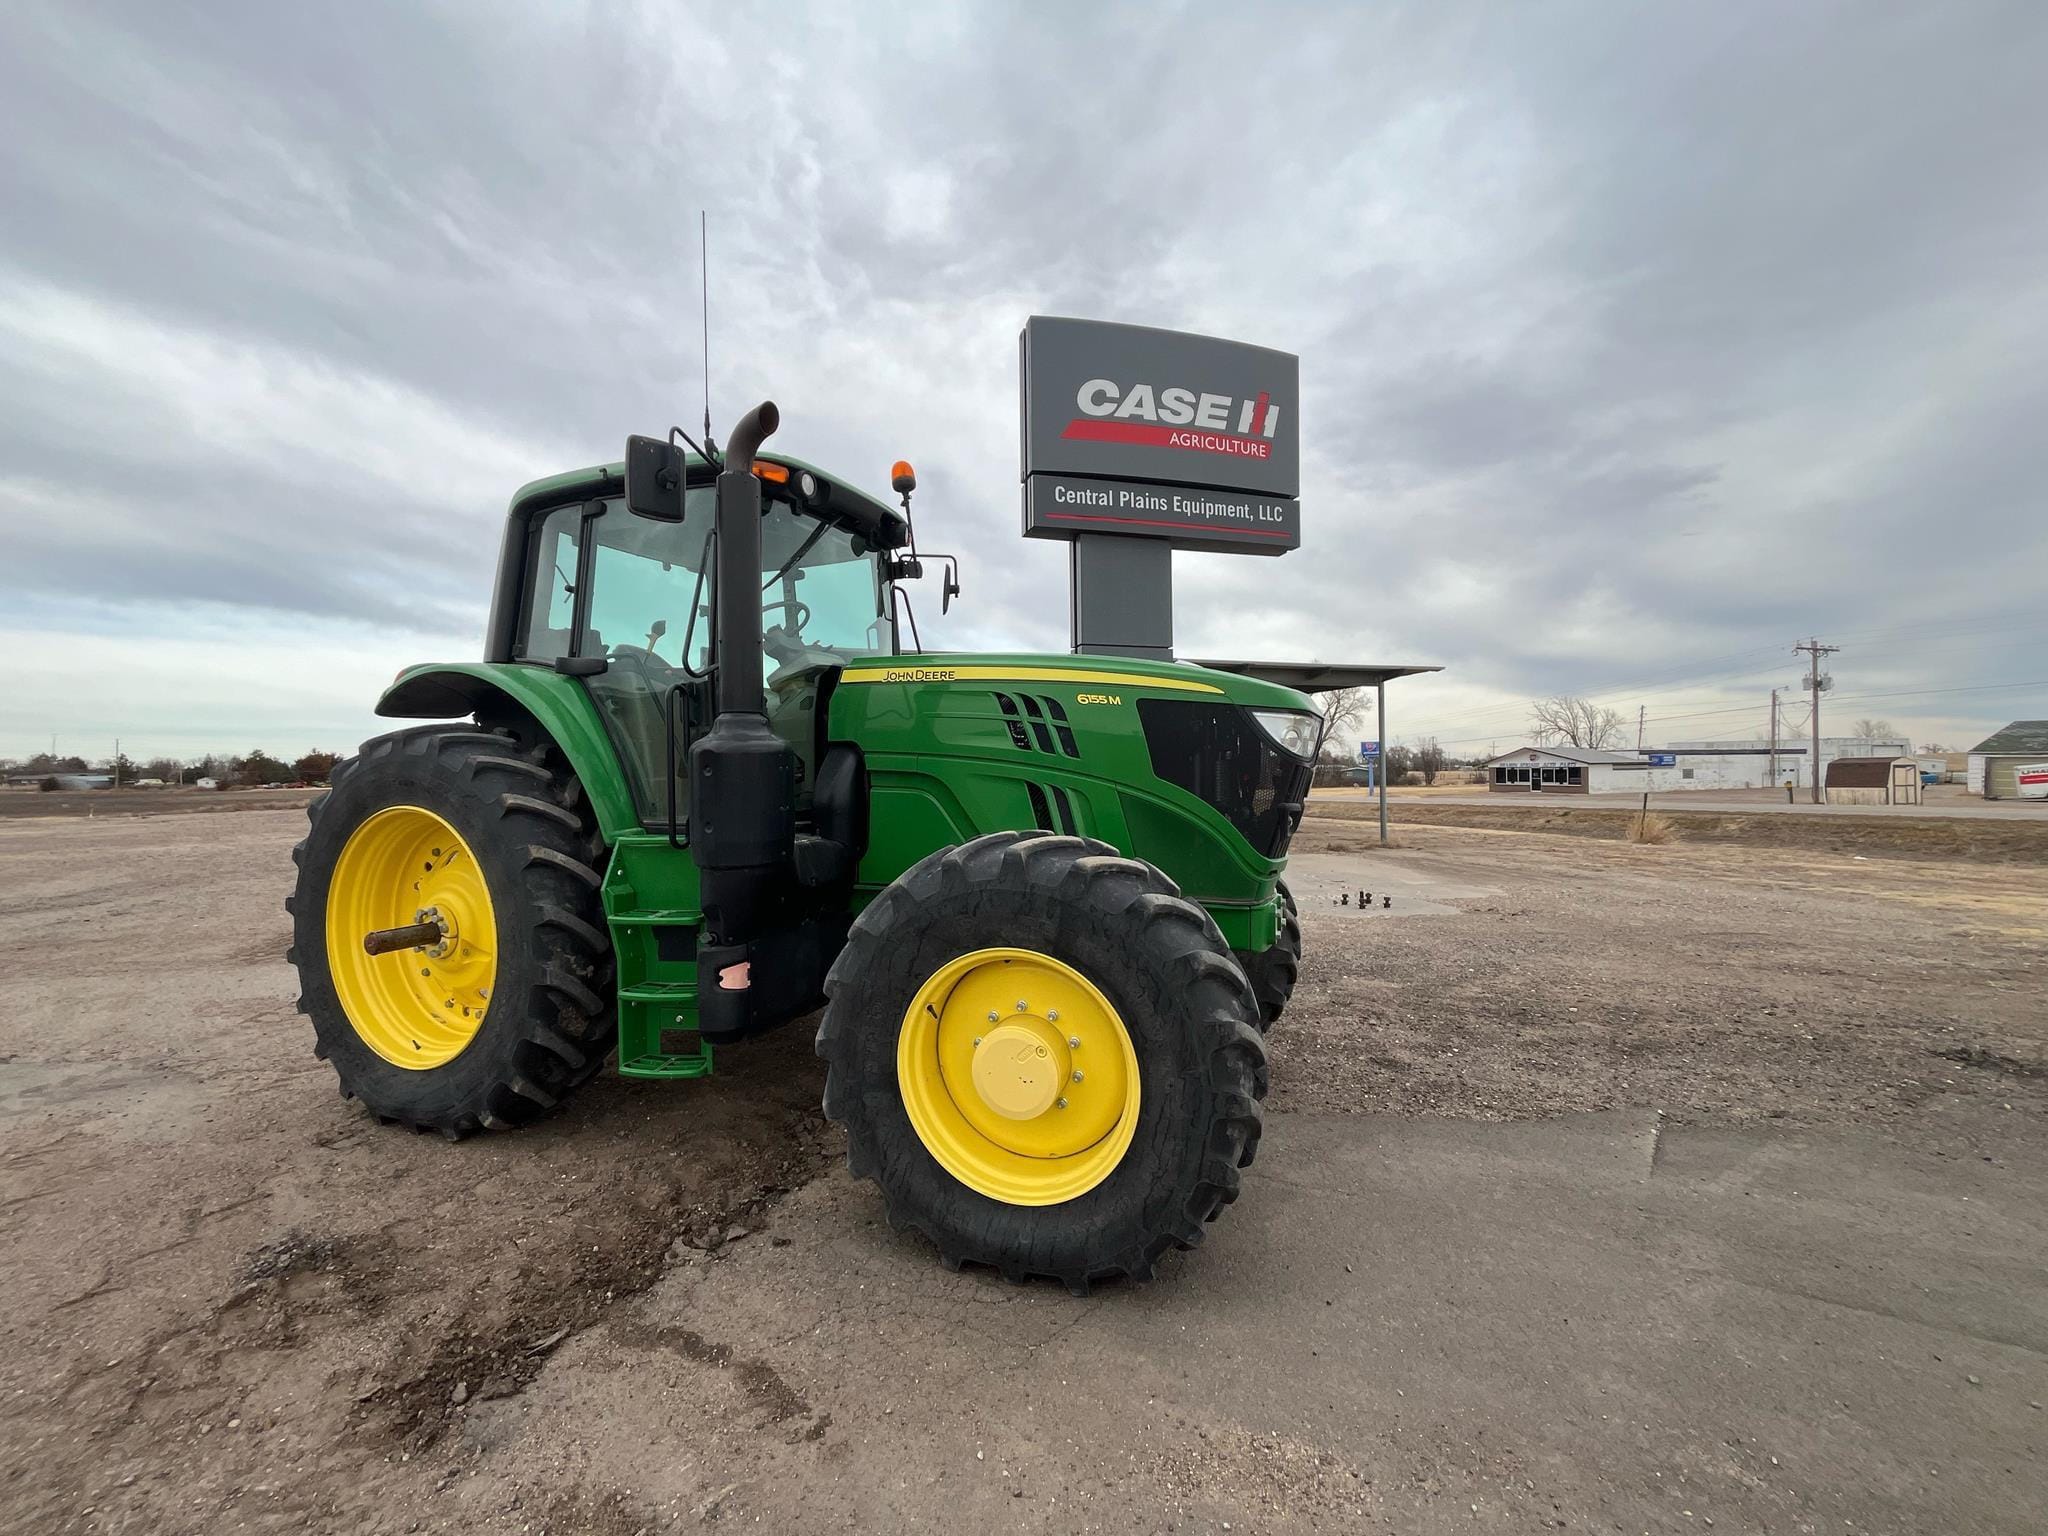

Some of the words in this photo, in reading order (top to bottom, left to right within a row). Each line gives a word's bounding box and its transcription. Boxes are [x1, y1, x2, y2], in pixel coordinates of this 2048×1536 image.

[1076, 379, 1233, 430] CASE
[1169, 432, 1267, 458] AGRICULTURE
[1054, 485, 1114, 507] Central
[1119, 490, 1168, 511] Plains
[1173, 496, 1254, 522] Equipment,
[1258, 505, 1283, 522] LLC
[882, 671, 914, 681] JOHN
[915, 670, 956, 680] DEERE
